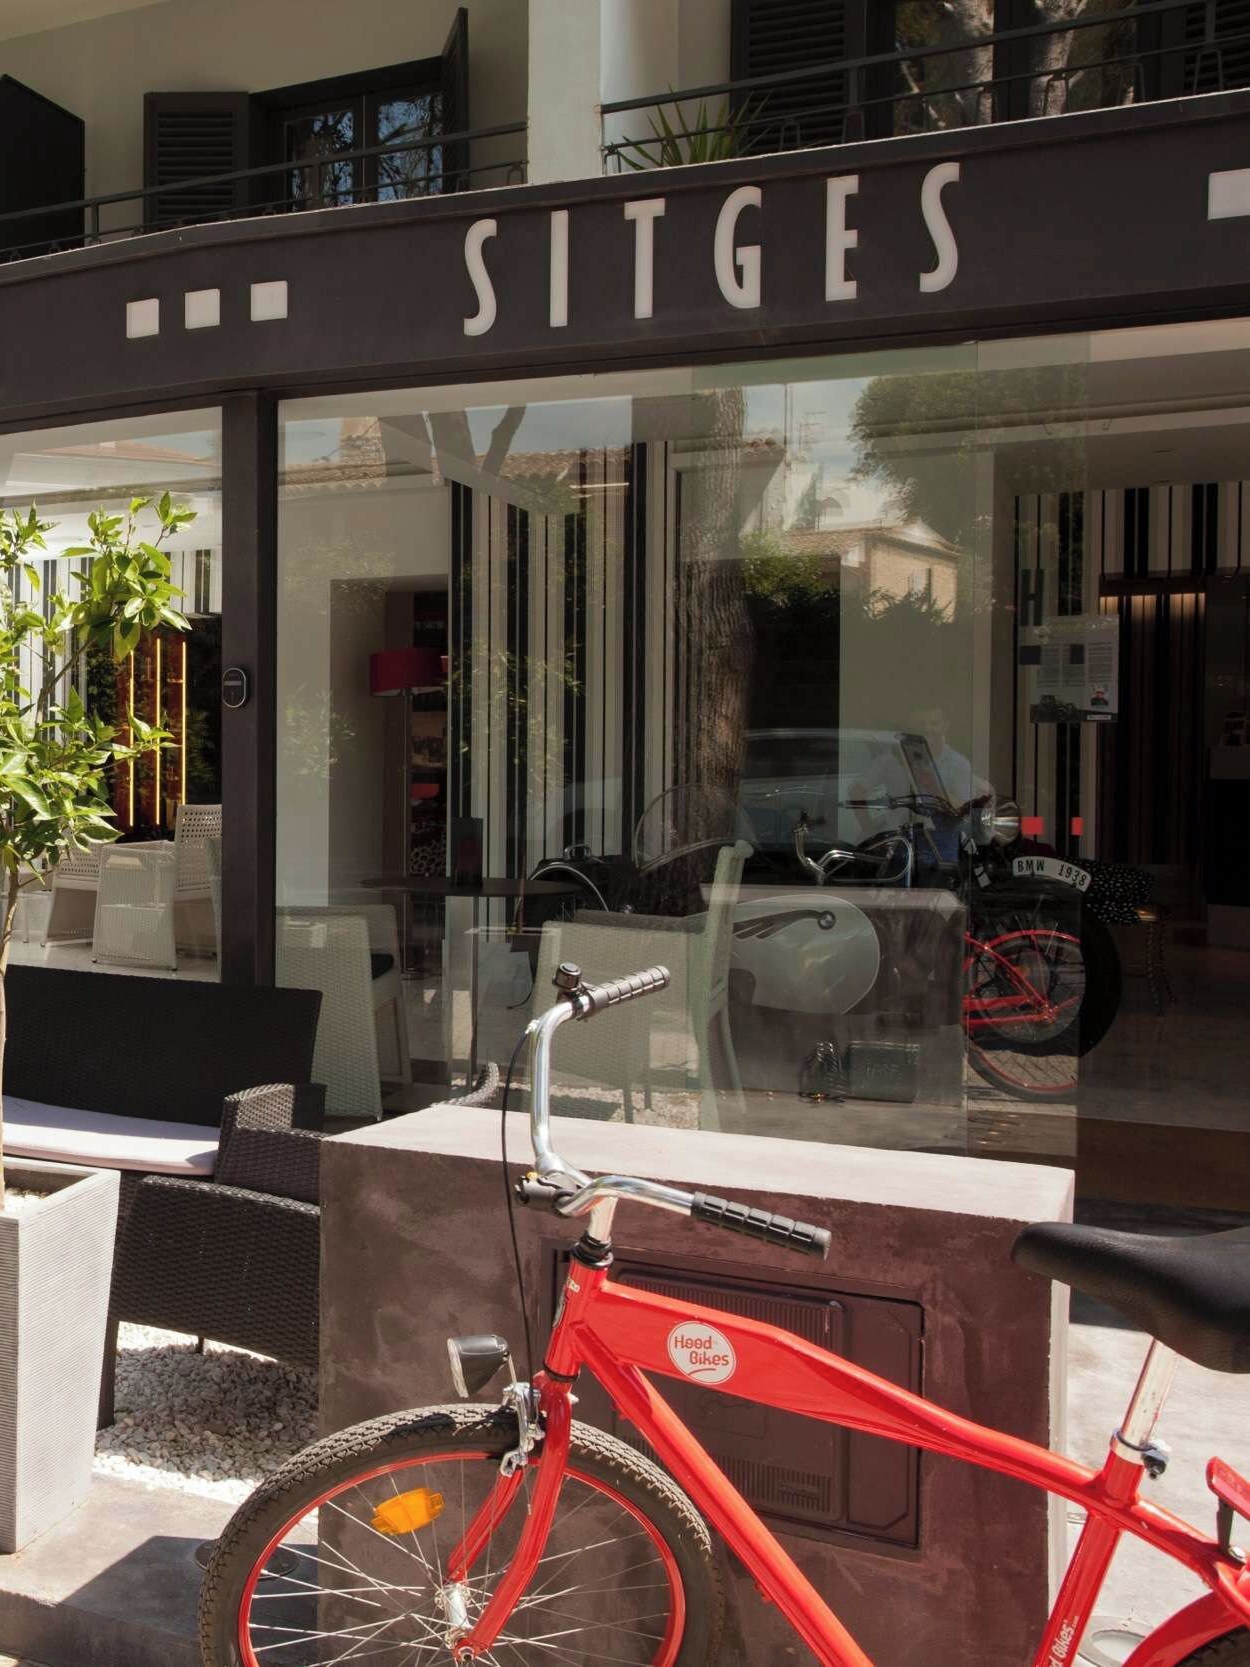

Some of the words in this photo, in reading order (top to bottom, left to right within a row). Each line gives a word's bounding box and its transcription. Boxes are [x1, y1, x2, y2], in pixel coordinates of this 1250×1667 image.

[463, 162, 960, 336] SITGES
[1017, 859, 1045, 873] BMW
[1058, 864, 1087, 887] 1938
[690, 1351, 730, 1366] Bikes
